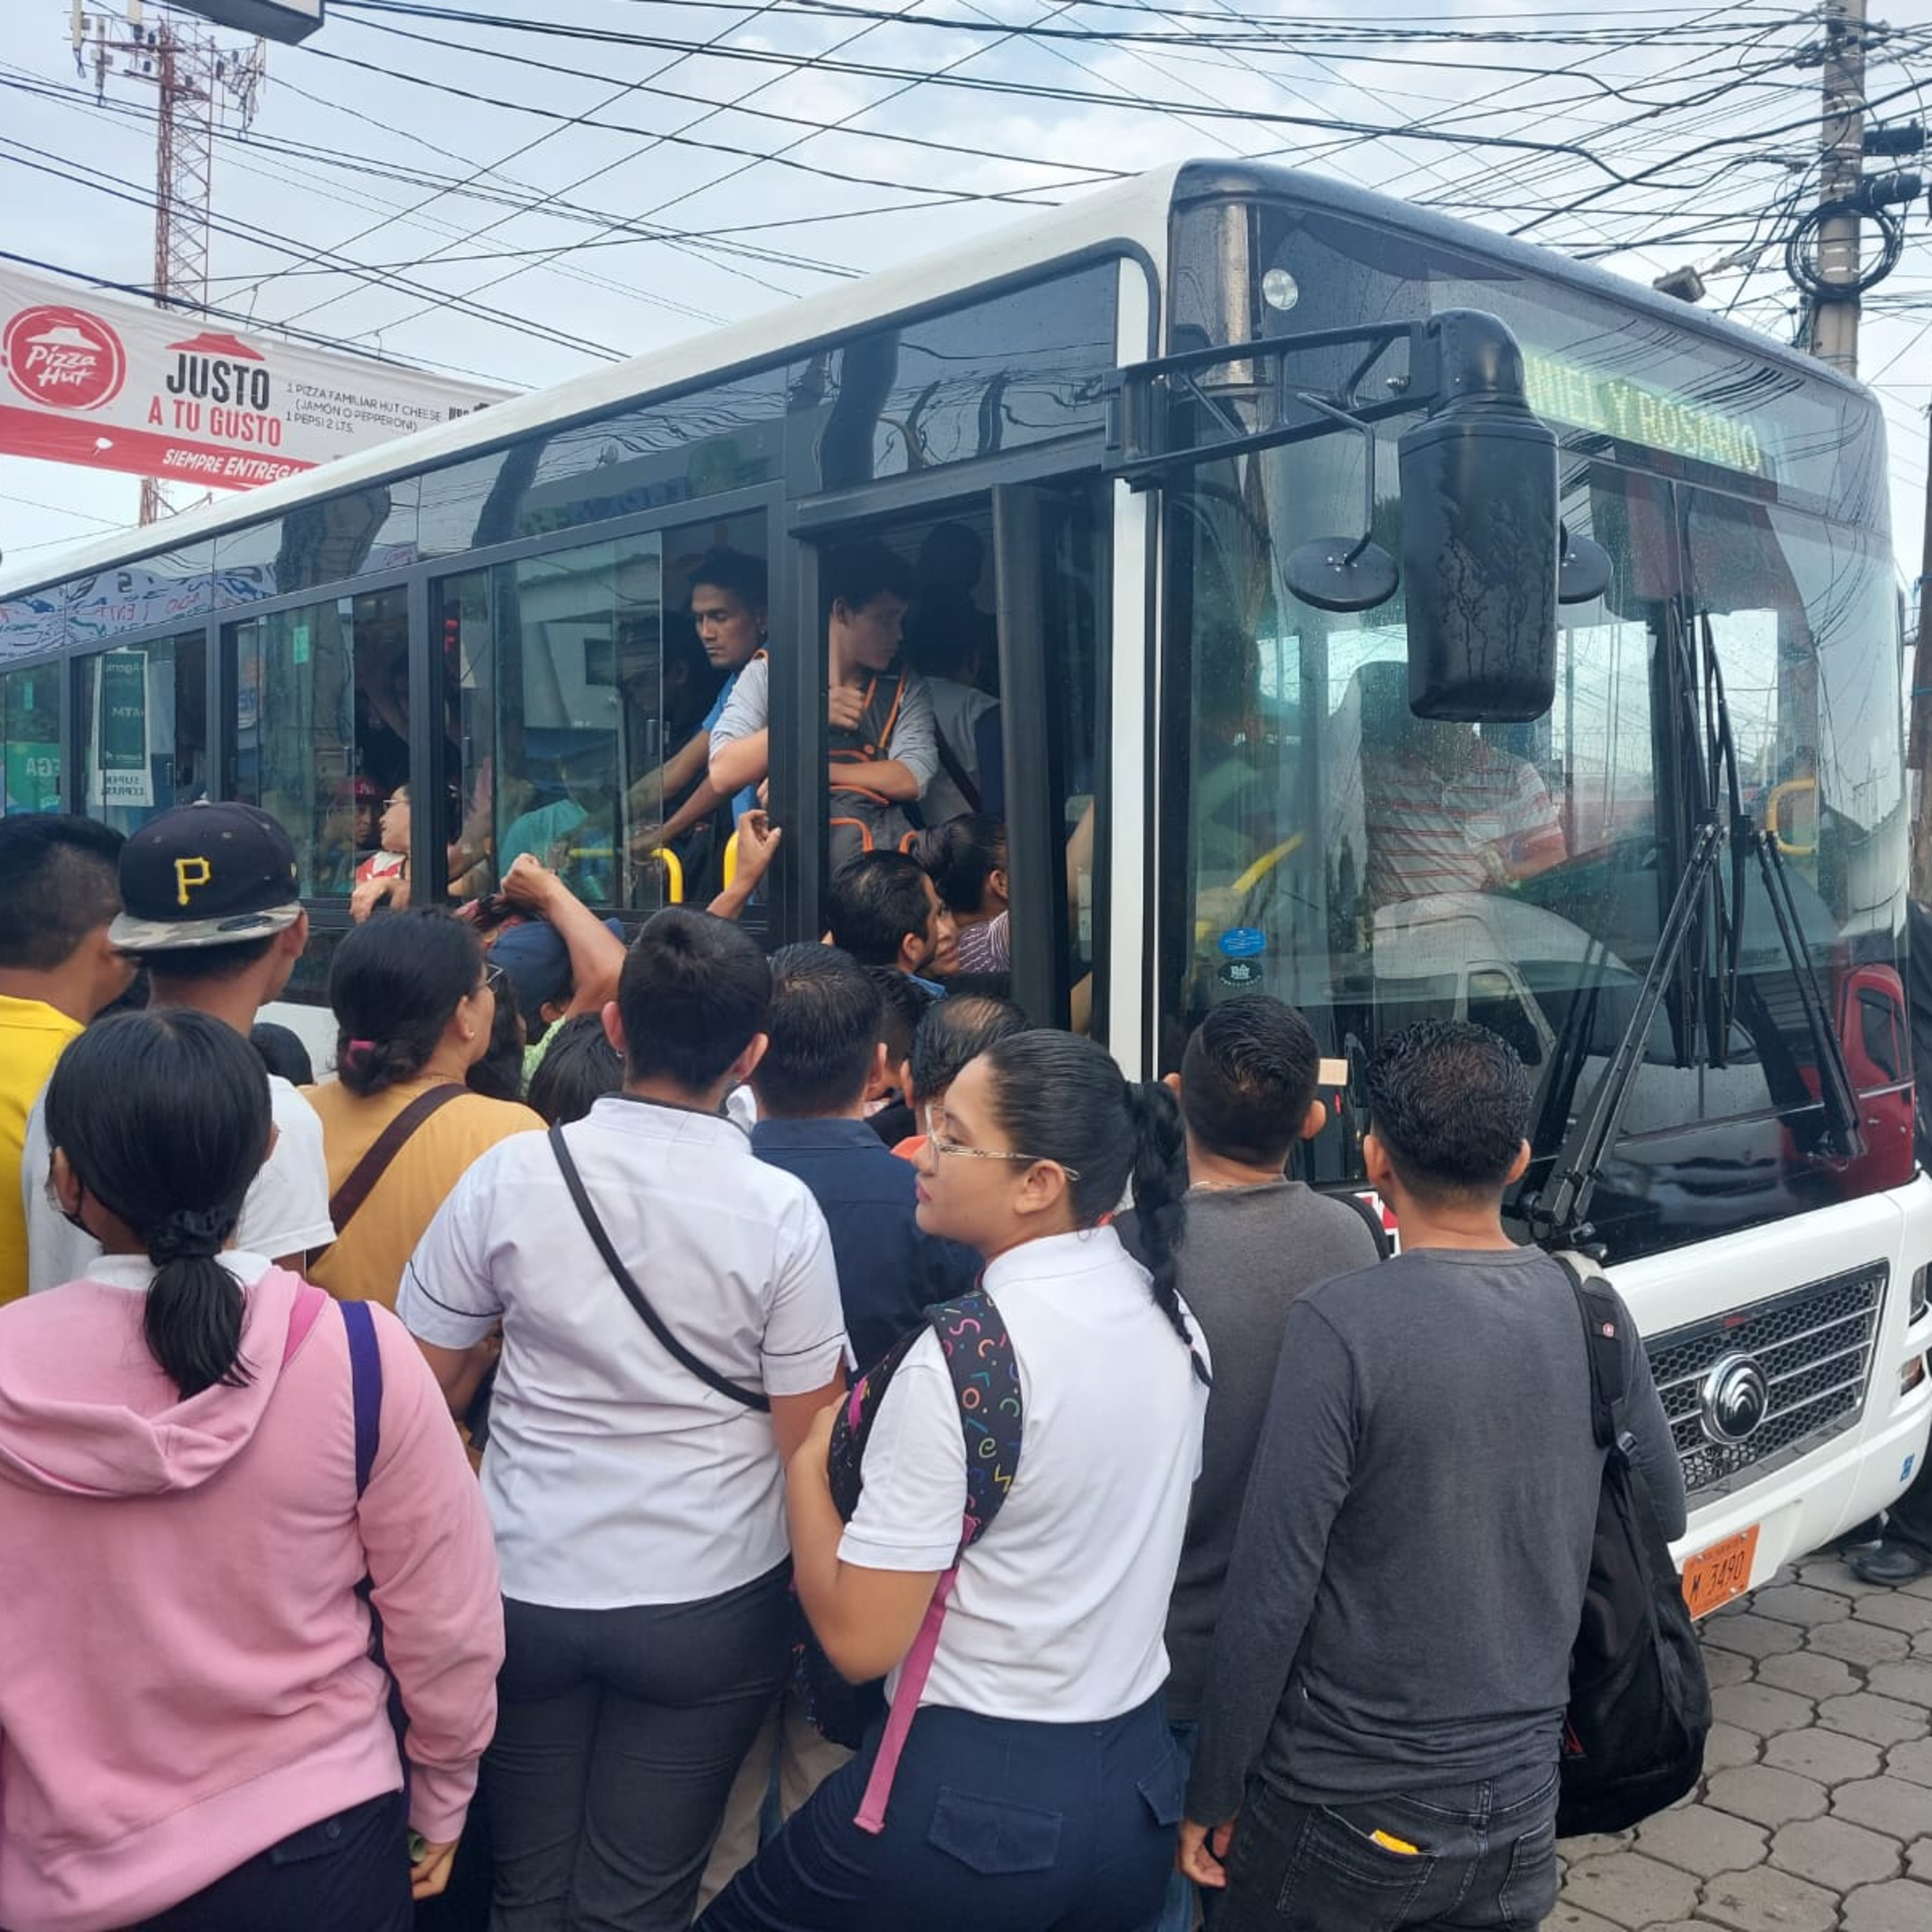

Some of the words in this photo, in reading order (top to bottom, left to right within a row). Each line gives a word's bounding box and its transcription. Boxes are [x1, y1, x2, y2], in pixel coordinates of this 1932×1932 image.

[25, 345, 97, 370] Pizza
[37, 366, 94, 387] Hut
[166, 352, 270, 411] JUSTO
[286, 383, 294, 393] 1
[295, 384, 327, 399] PIZZA
[329, 390, 377, 409] FAMILIAR
[379, 399, 400, 413] HUT
[402, 405, 442, 422] CHEESE
[148, 394, 163, 426] A
[173, 399, 200, 432] TU
[209, 406, 281, 447] GUSTO
[285, 412, 290, 421] 1
[294, 413, 325, 427] PEPSI
[326, 419, 333, 429] 2
[342, 407, 353, 419] O
[354, 410, 417, 433] PEPPERONI)
[1607, 381, 1629, 434] Y
[1638, 390, 1761, 472] ROSARIO
[162, 448, 224, 474] SIEMPRE
[174, 857, 211, 905] P
